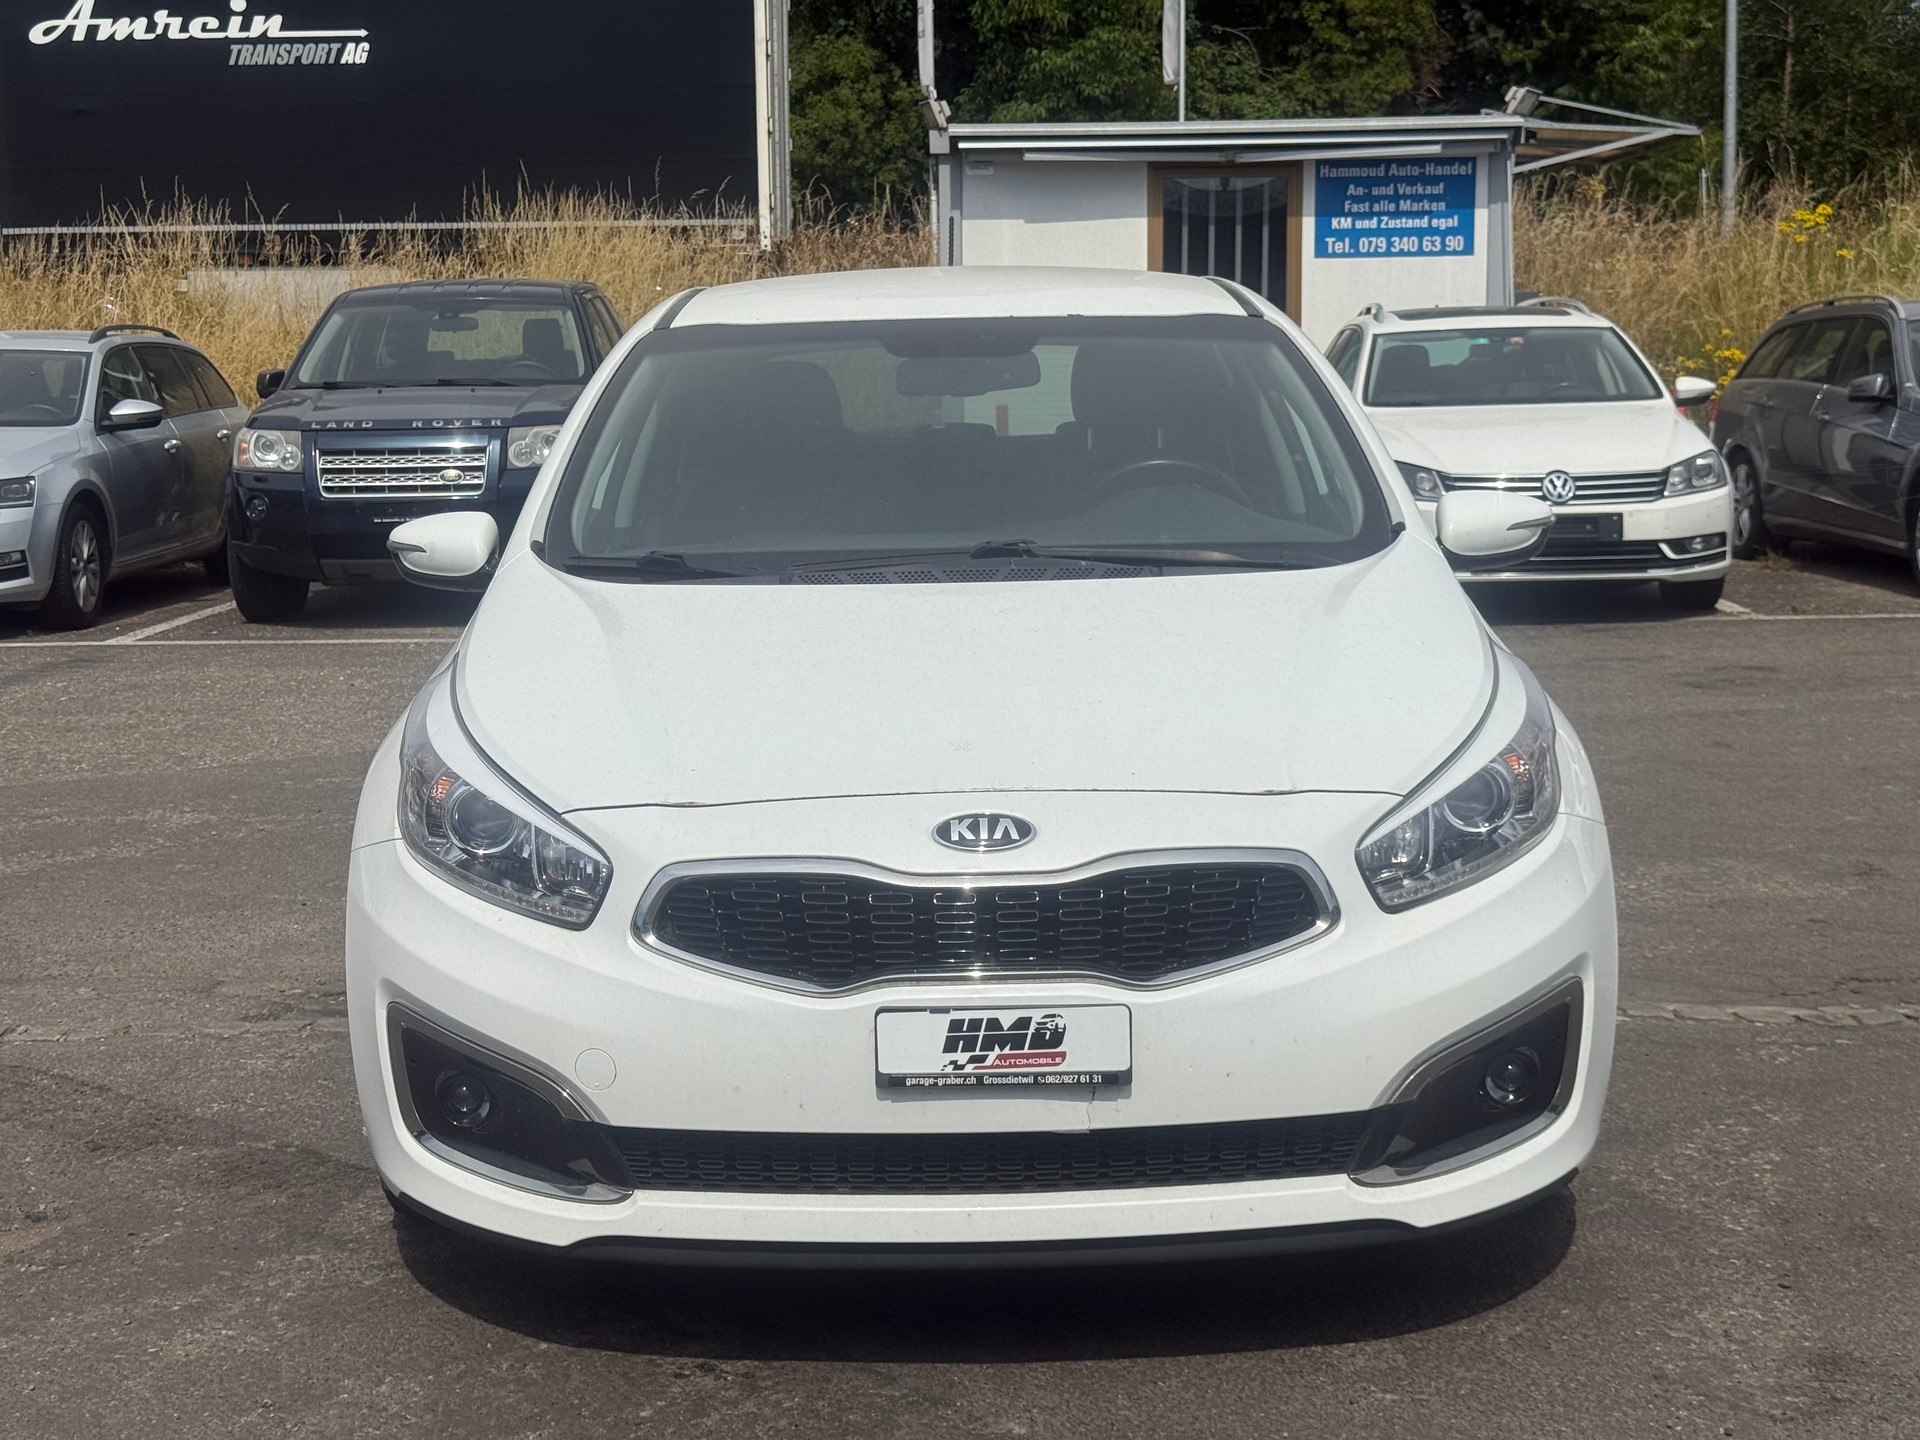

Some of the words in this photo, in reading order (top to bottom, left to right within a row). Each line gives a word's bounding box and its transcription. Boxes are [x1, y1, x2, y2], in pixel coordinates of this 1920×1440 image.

[228, 44, 341, 66] TRANSPORT
[340, 42, 371, 64] AG
[1320, 164, 1385, 178] Hammoud
[1389, 162, 1472, 177] Auto-Handel
[1347, 184, 1368, 196] An-
[1372, 183, 1394, 195] und
[1398, 182, 1444, 195] Verkauf
[1345, 201, 1369, 213] Fast
[1373, 201, 1396, 212] alle
[1400, 200, 1446, 212] Marken
[1332, 217, 1351, 229] KM
[1355, 216, 1378, 229] und
[1380, 216, 1428, 229] Zustand
[1431, 215, 1458, 230] egal
[1325, 237, 1354, 254] Tel.
[1359, 237, 1387, 253] 079
[1391, 236, 1418, 252] 340
[1422, 236, 1441, 252] 63
[1445, 235, 1464, 251] 90
[311, 421, 373, 429] LAND
[412, 418, 502, 428] ROVER
[949, 817, 1020, 841] KIA
[992, 1057, 1063, 1067] AUTOMOBILE
[905, 1075, 977, 1087] garage-graber.ch
[983, 1075, 1034, 1085] Grossdietwil
[1045, 1074, 1077, 1084] 062/927
[1080, 1074, 1090, 1083] 61
[1092, 1074, 1102, 1083] 31
